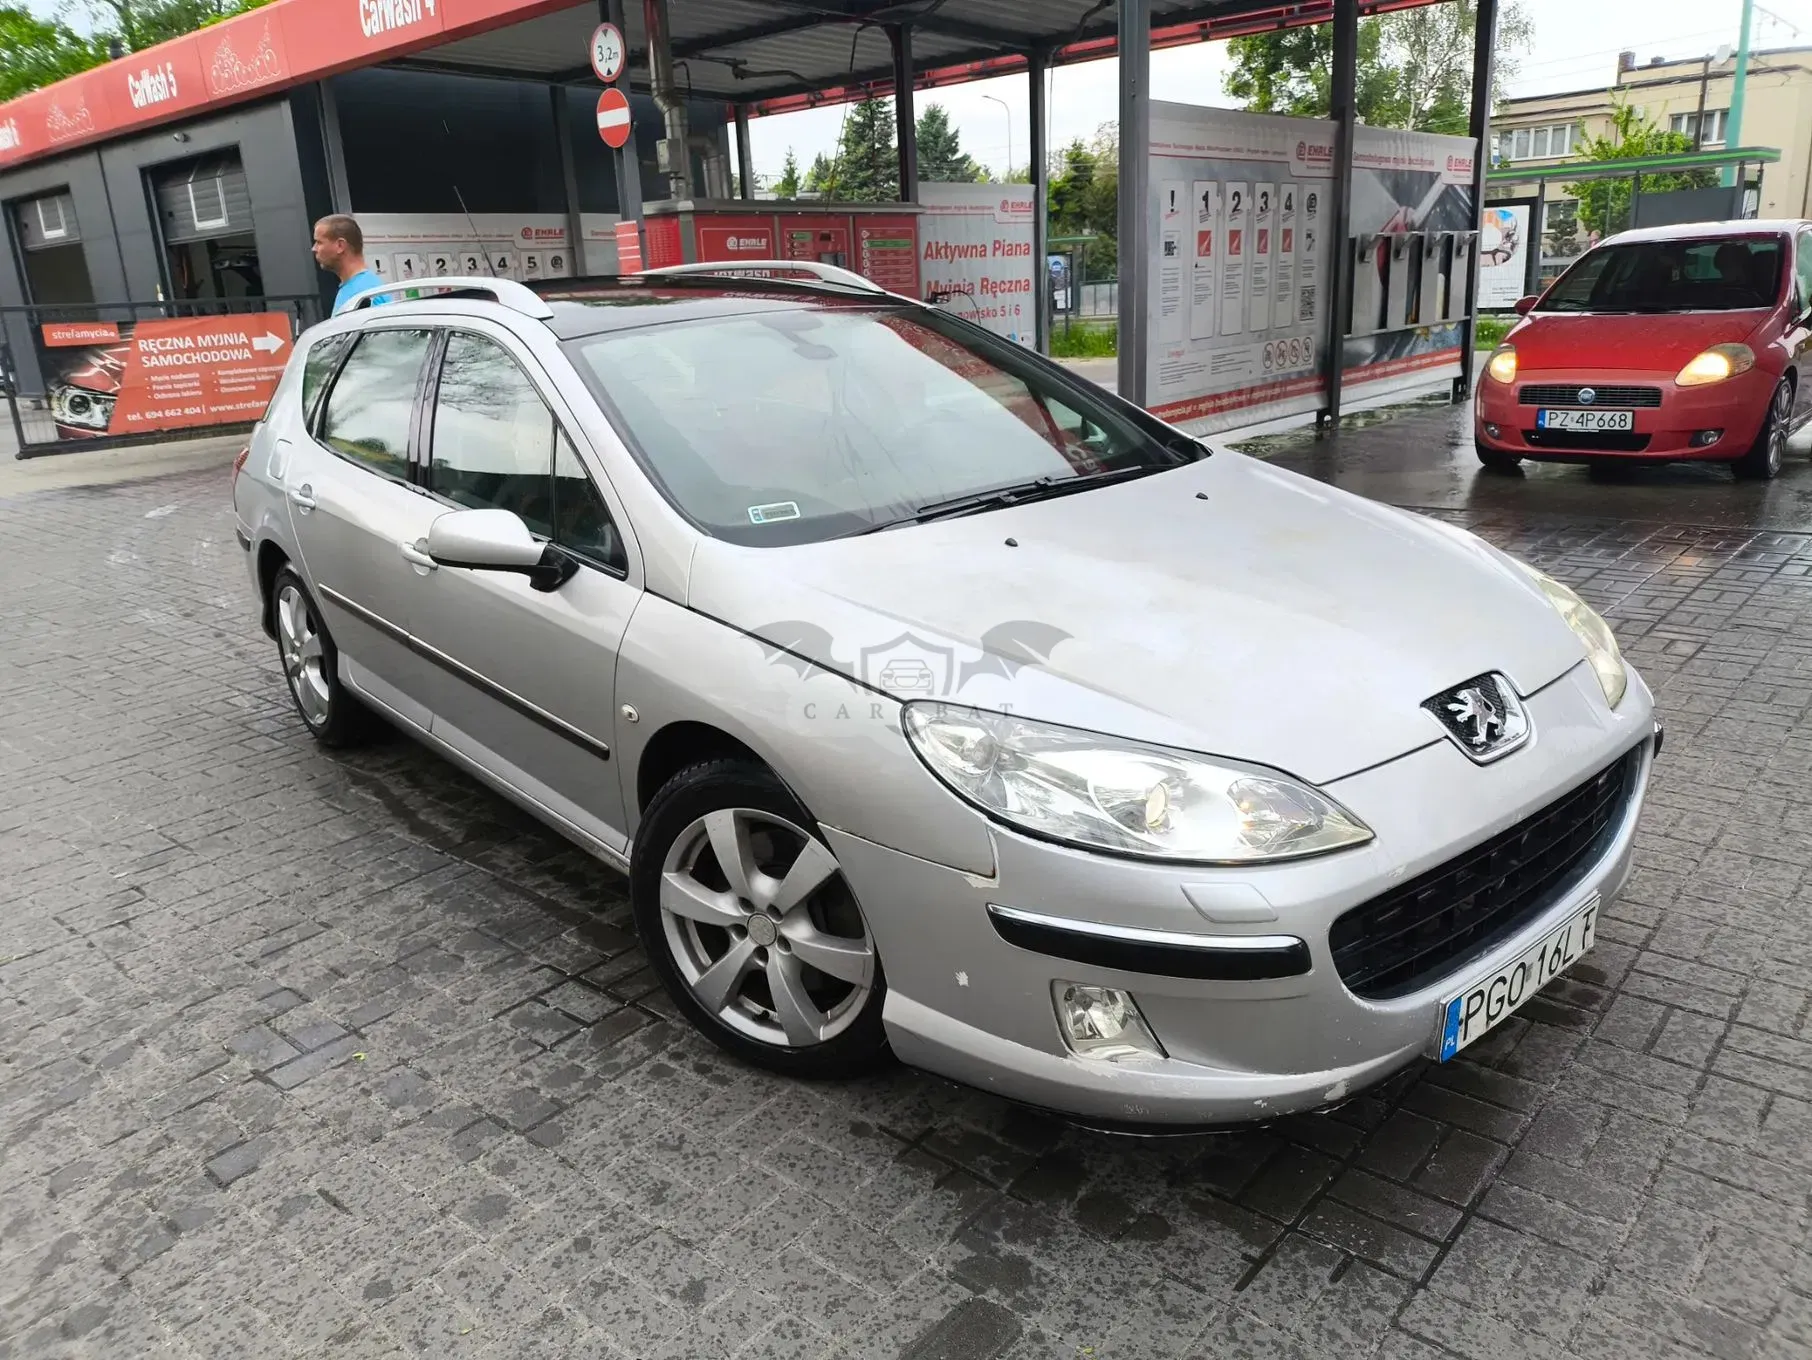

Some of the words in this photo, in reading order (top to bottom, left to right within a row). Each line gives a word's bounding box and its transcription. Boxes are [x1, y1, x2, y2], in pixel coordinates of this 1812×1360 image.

[127, 67, 167, 109] CarWash
[167, 62, 177, 97] 5
[534, 228, 565, 236] EHRLE
[740, 238, 767, 246] EHRLE
[924, 241, 987, 264] Aktywna
[992, 239, 1031, 257] Piana
[926, 278, 975, 298] Myjnia
[980, 277, 1031, 298] Ręczna
[1000, 305, 1006, 317] 5
[1014, 304, 1021, 316] 6
[138, 336, 195, 353] RĘCZNA
[197, 332, 249, 348] MYJNIA
[141, 349, 253, 368] SAMOCHODOWA
[127, 412, 143, 422] tel.
[145, 409, 163, 419] 694
[164, 407, 183, 417] 662
[184, 406, 201, 416] 404
[1548, 411, 1570, 427] PZ
[1575, 412, 1628, 429] 4P668
[1462, 961, 1527, 1041] PGO
[1537, 906, 1595, 986] 16LT
